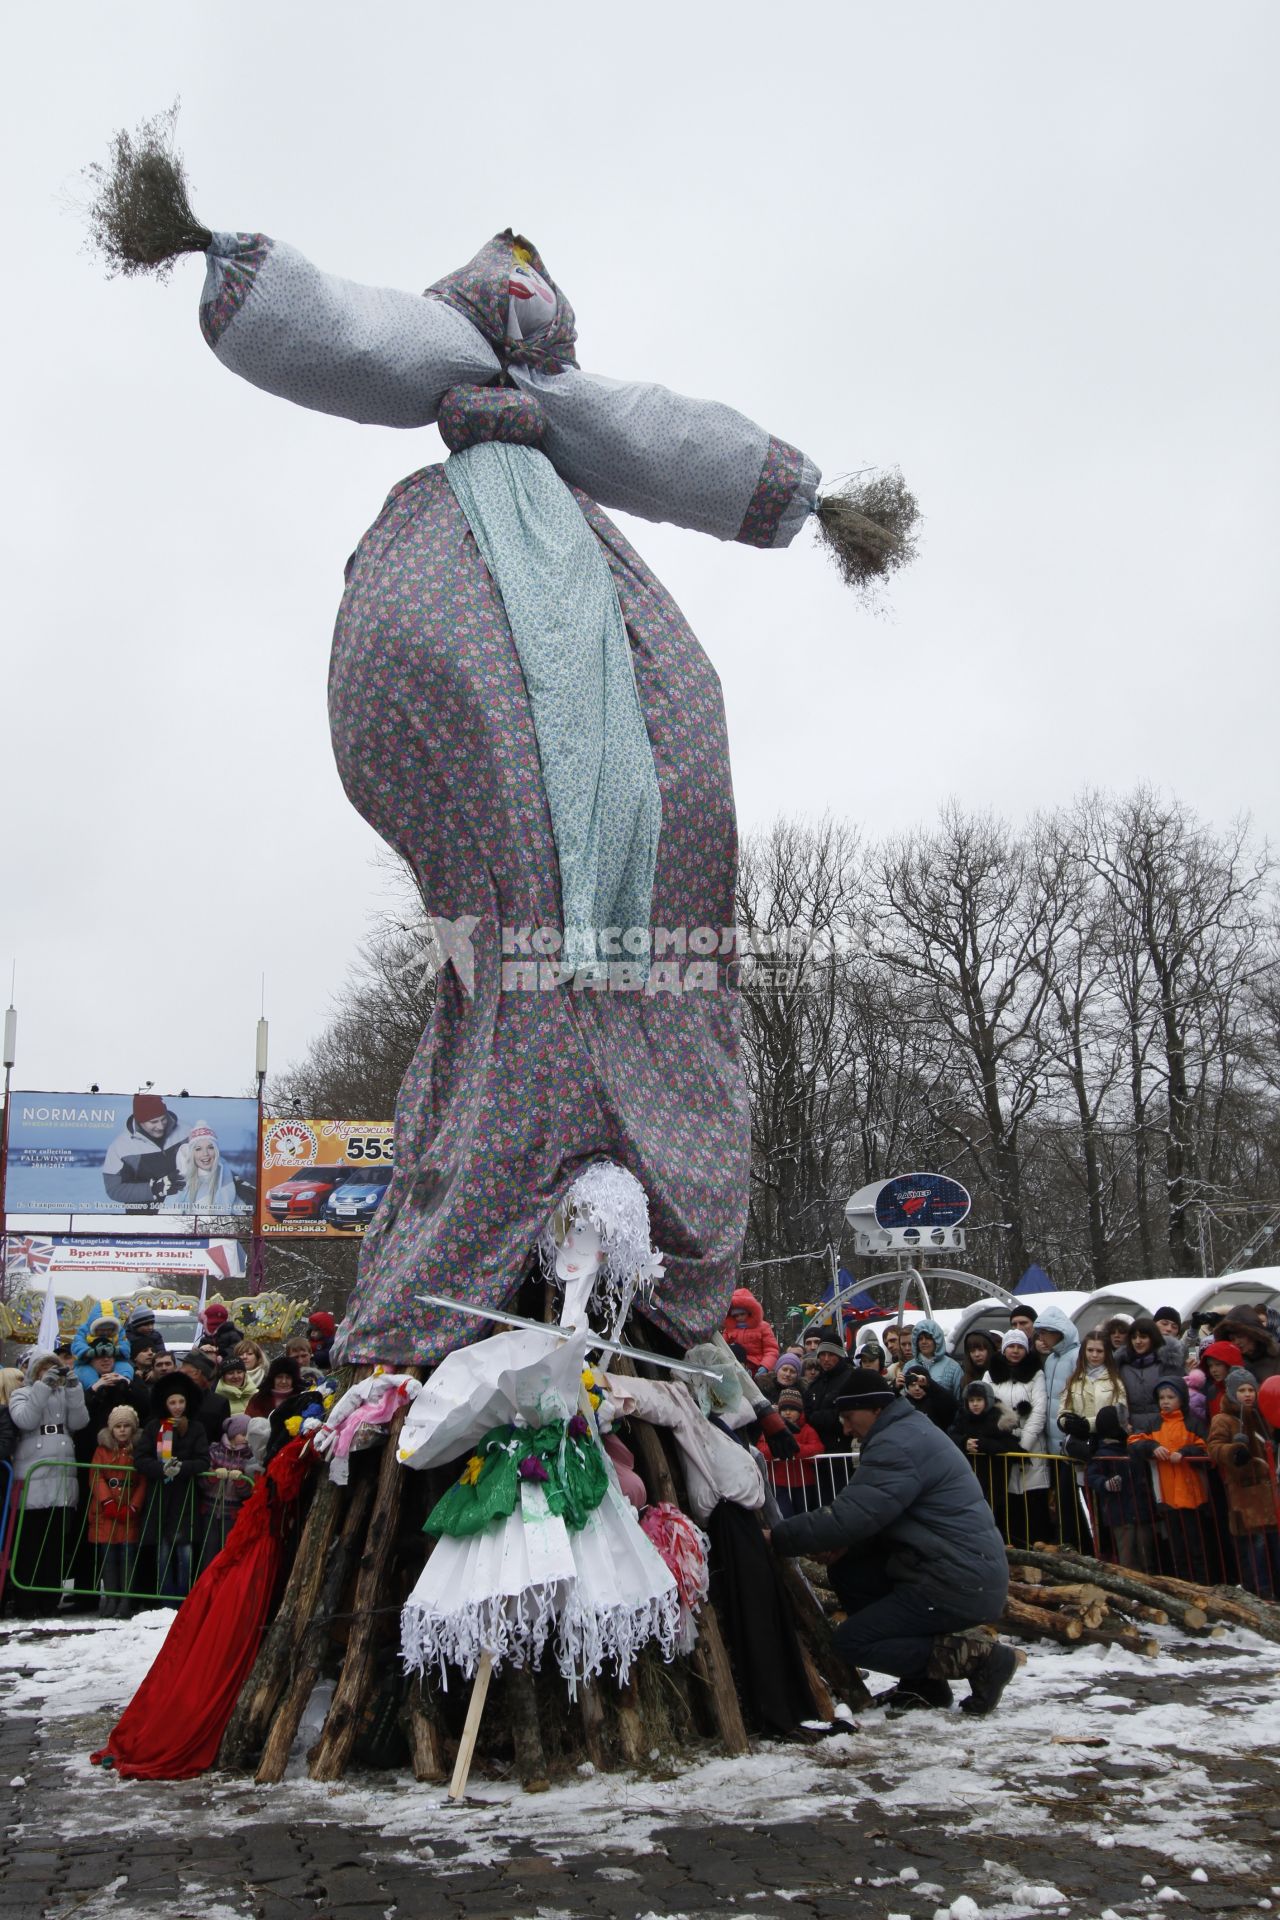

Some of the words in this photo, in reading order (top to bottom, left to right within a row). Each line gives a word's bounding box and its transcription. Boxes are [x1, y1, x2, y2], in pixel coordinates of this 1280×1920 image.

[23, 1107, 115, 1122] NORMANN
[273, 1125, 310, 1142] ТАКСИ
[323, 1120, 394, 1139] Жужжим
[262, 1223, 327, 1232] Online-заказ
[69, 1248, 110, 1258] Время
[115, 1250, 153, 1258] учить
[156, 1250, 193, 1259] язык!
